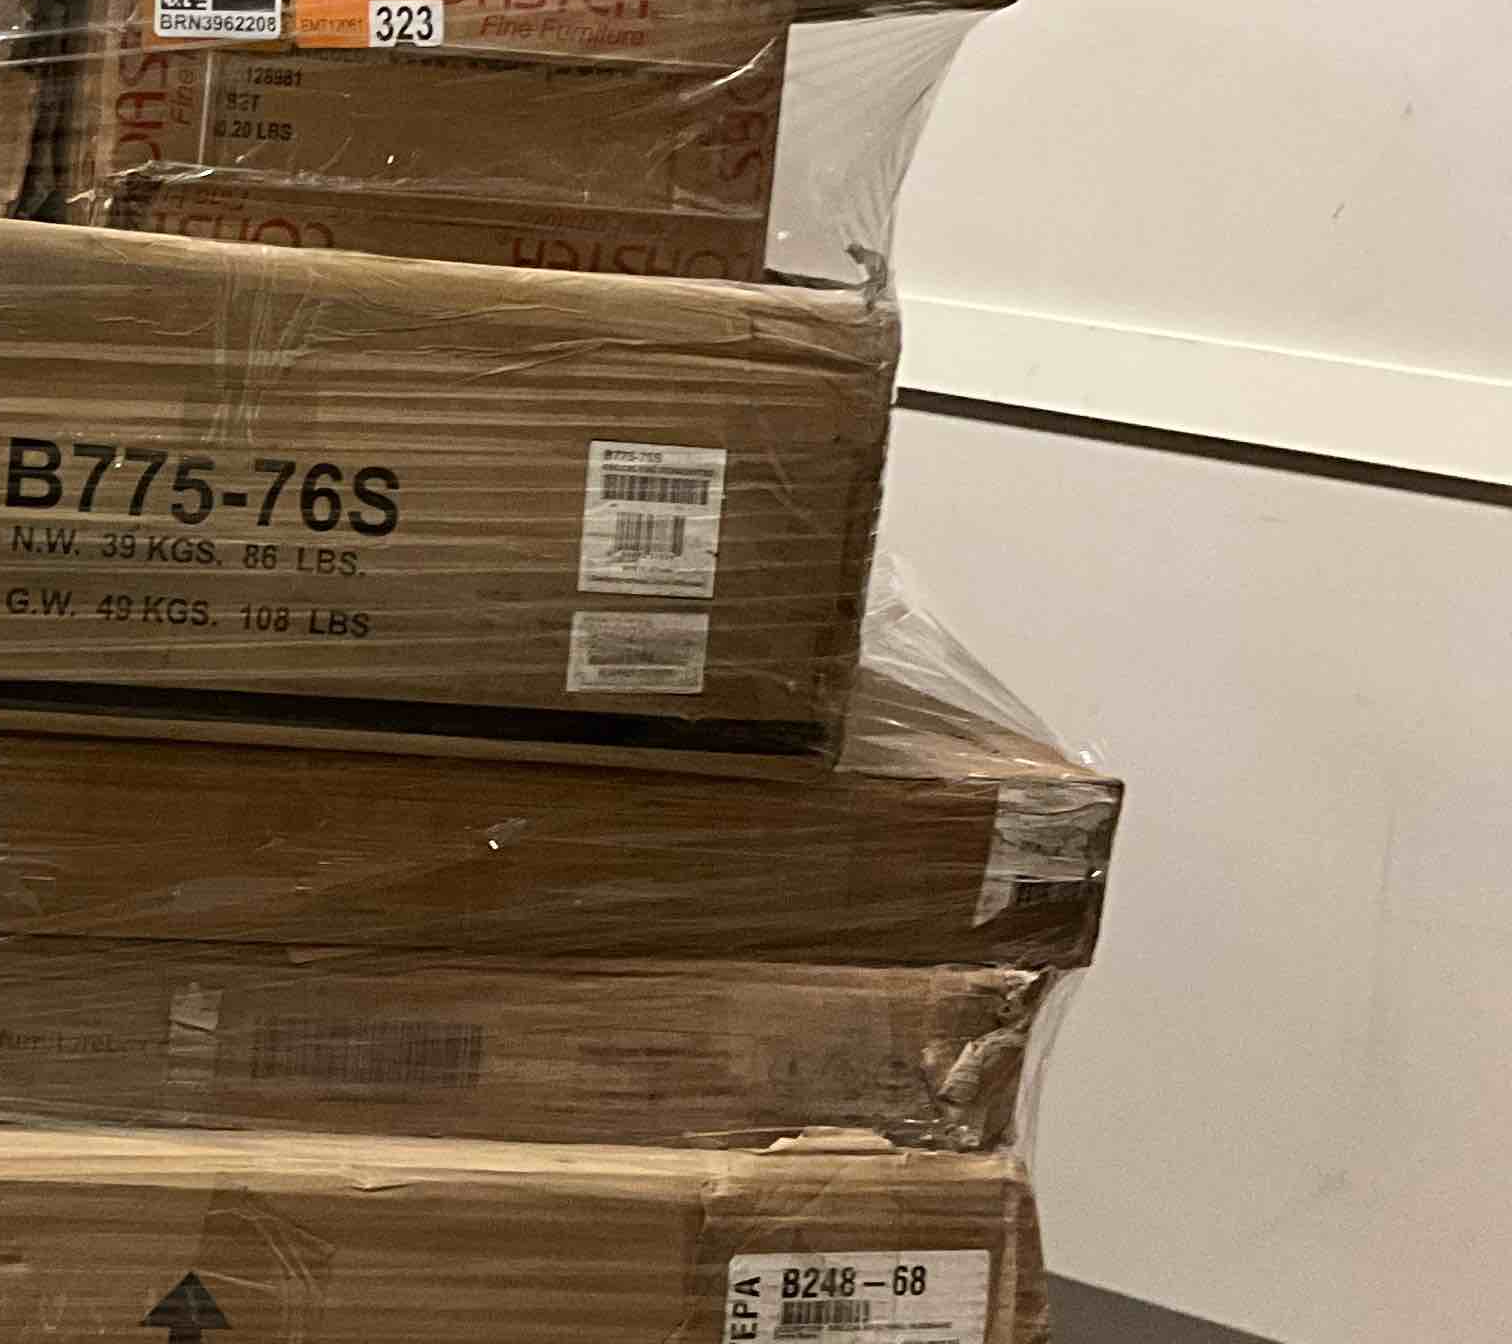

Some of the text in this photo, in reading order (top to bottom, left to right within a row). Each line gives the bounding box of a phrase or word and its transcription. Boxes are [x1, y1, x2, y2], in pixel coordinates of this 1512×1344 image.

[160, 13, 278, 33] BRN3962208
[376, 6, 434, 42] 323
[5, 437, 400, 537] B775-76S
[102, 533, 136, 558] 39
[145, 535, 223, 566] KGS.
[141, 595, 218, 626] KGS.
